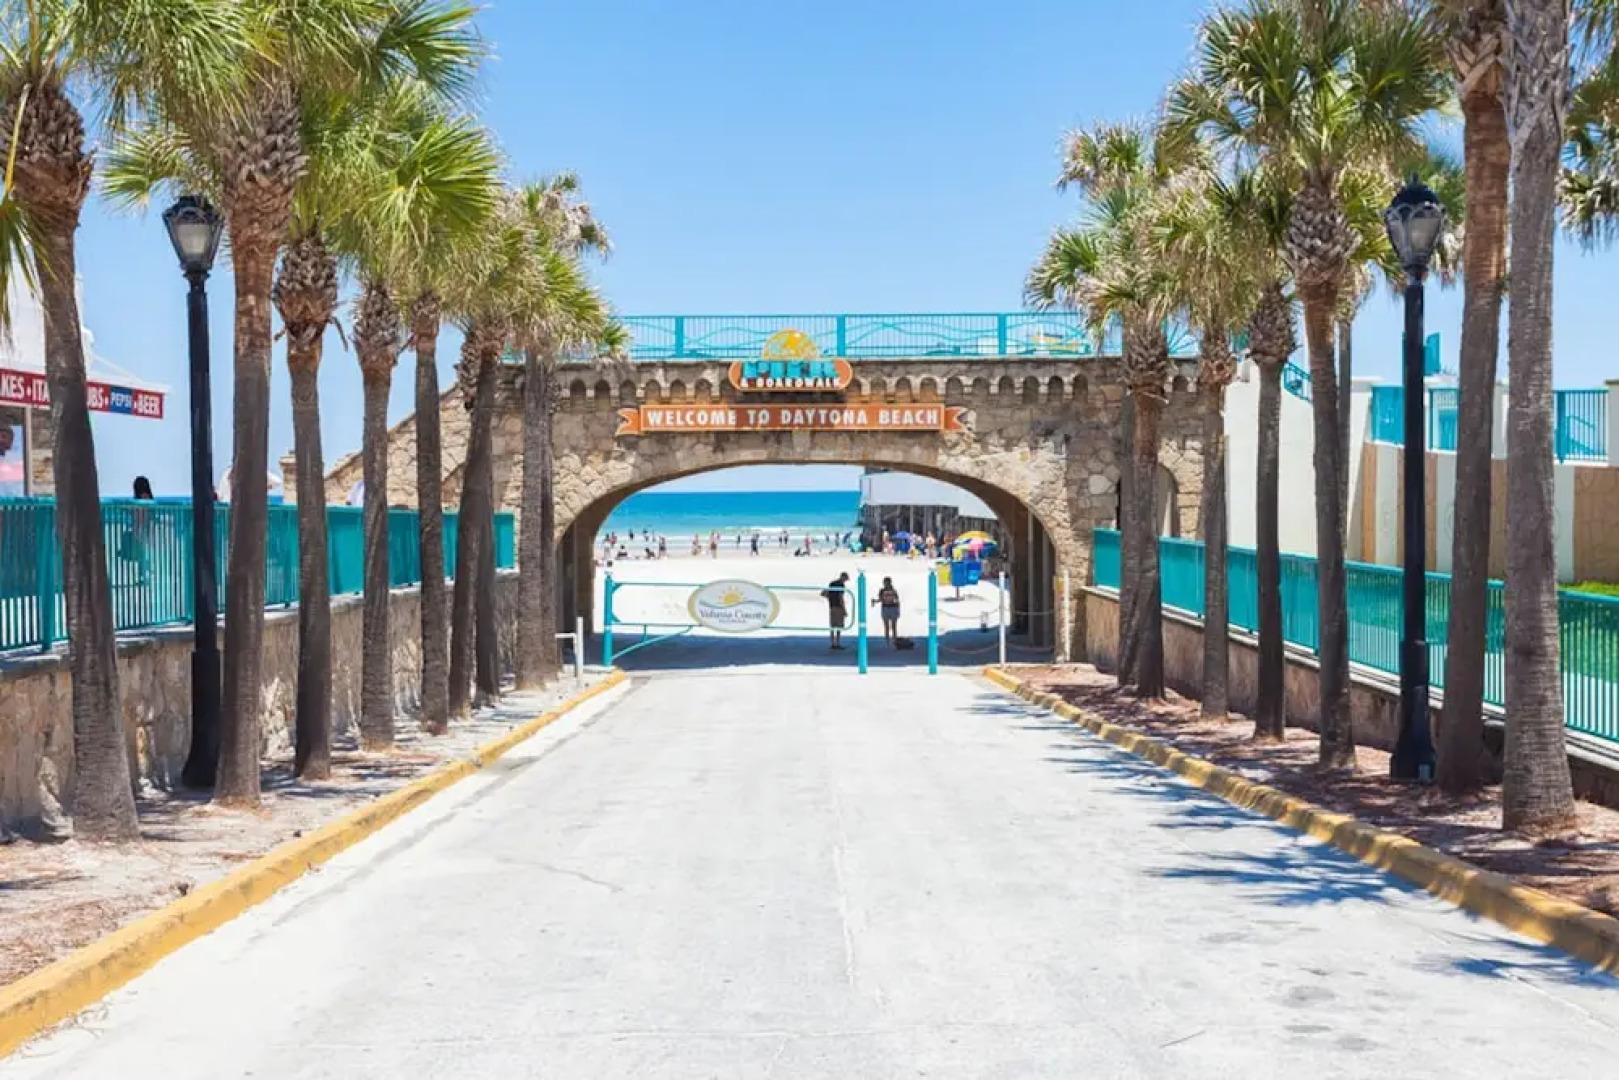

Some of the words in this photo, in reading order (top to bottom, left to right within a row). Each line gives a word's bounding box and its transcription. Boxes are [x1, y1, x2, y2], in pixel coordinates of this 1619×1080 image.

[110, 391, 132, 408] PEPSI
[138, 394, 160, 416] BEER
[647, 409, 736, 427] WELCOME
[747, 409, 770, 427] TO
[781, 409, 868, 427] DAYTONA
[879, 409, 938, 427] BEACH
